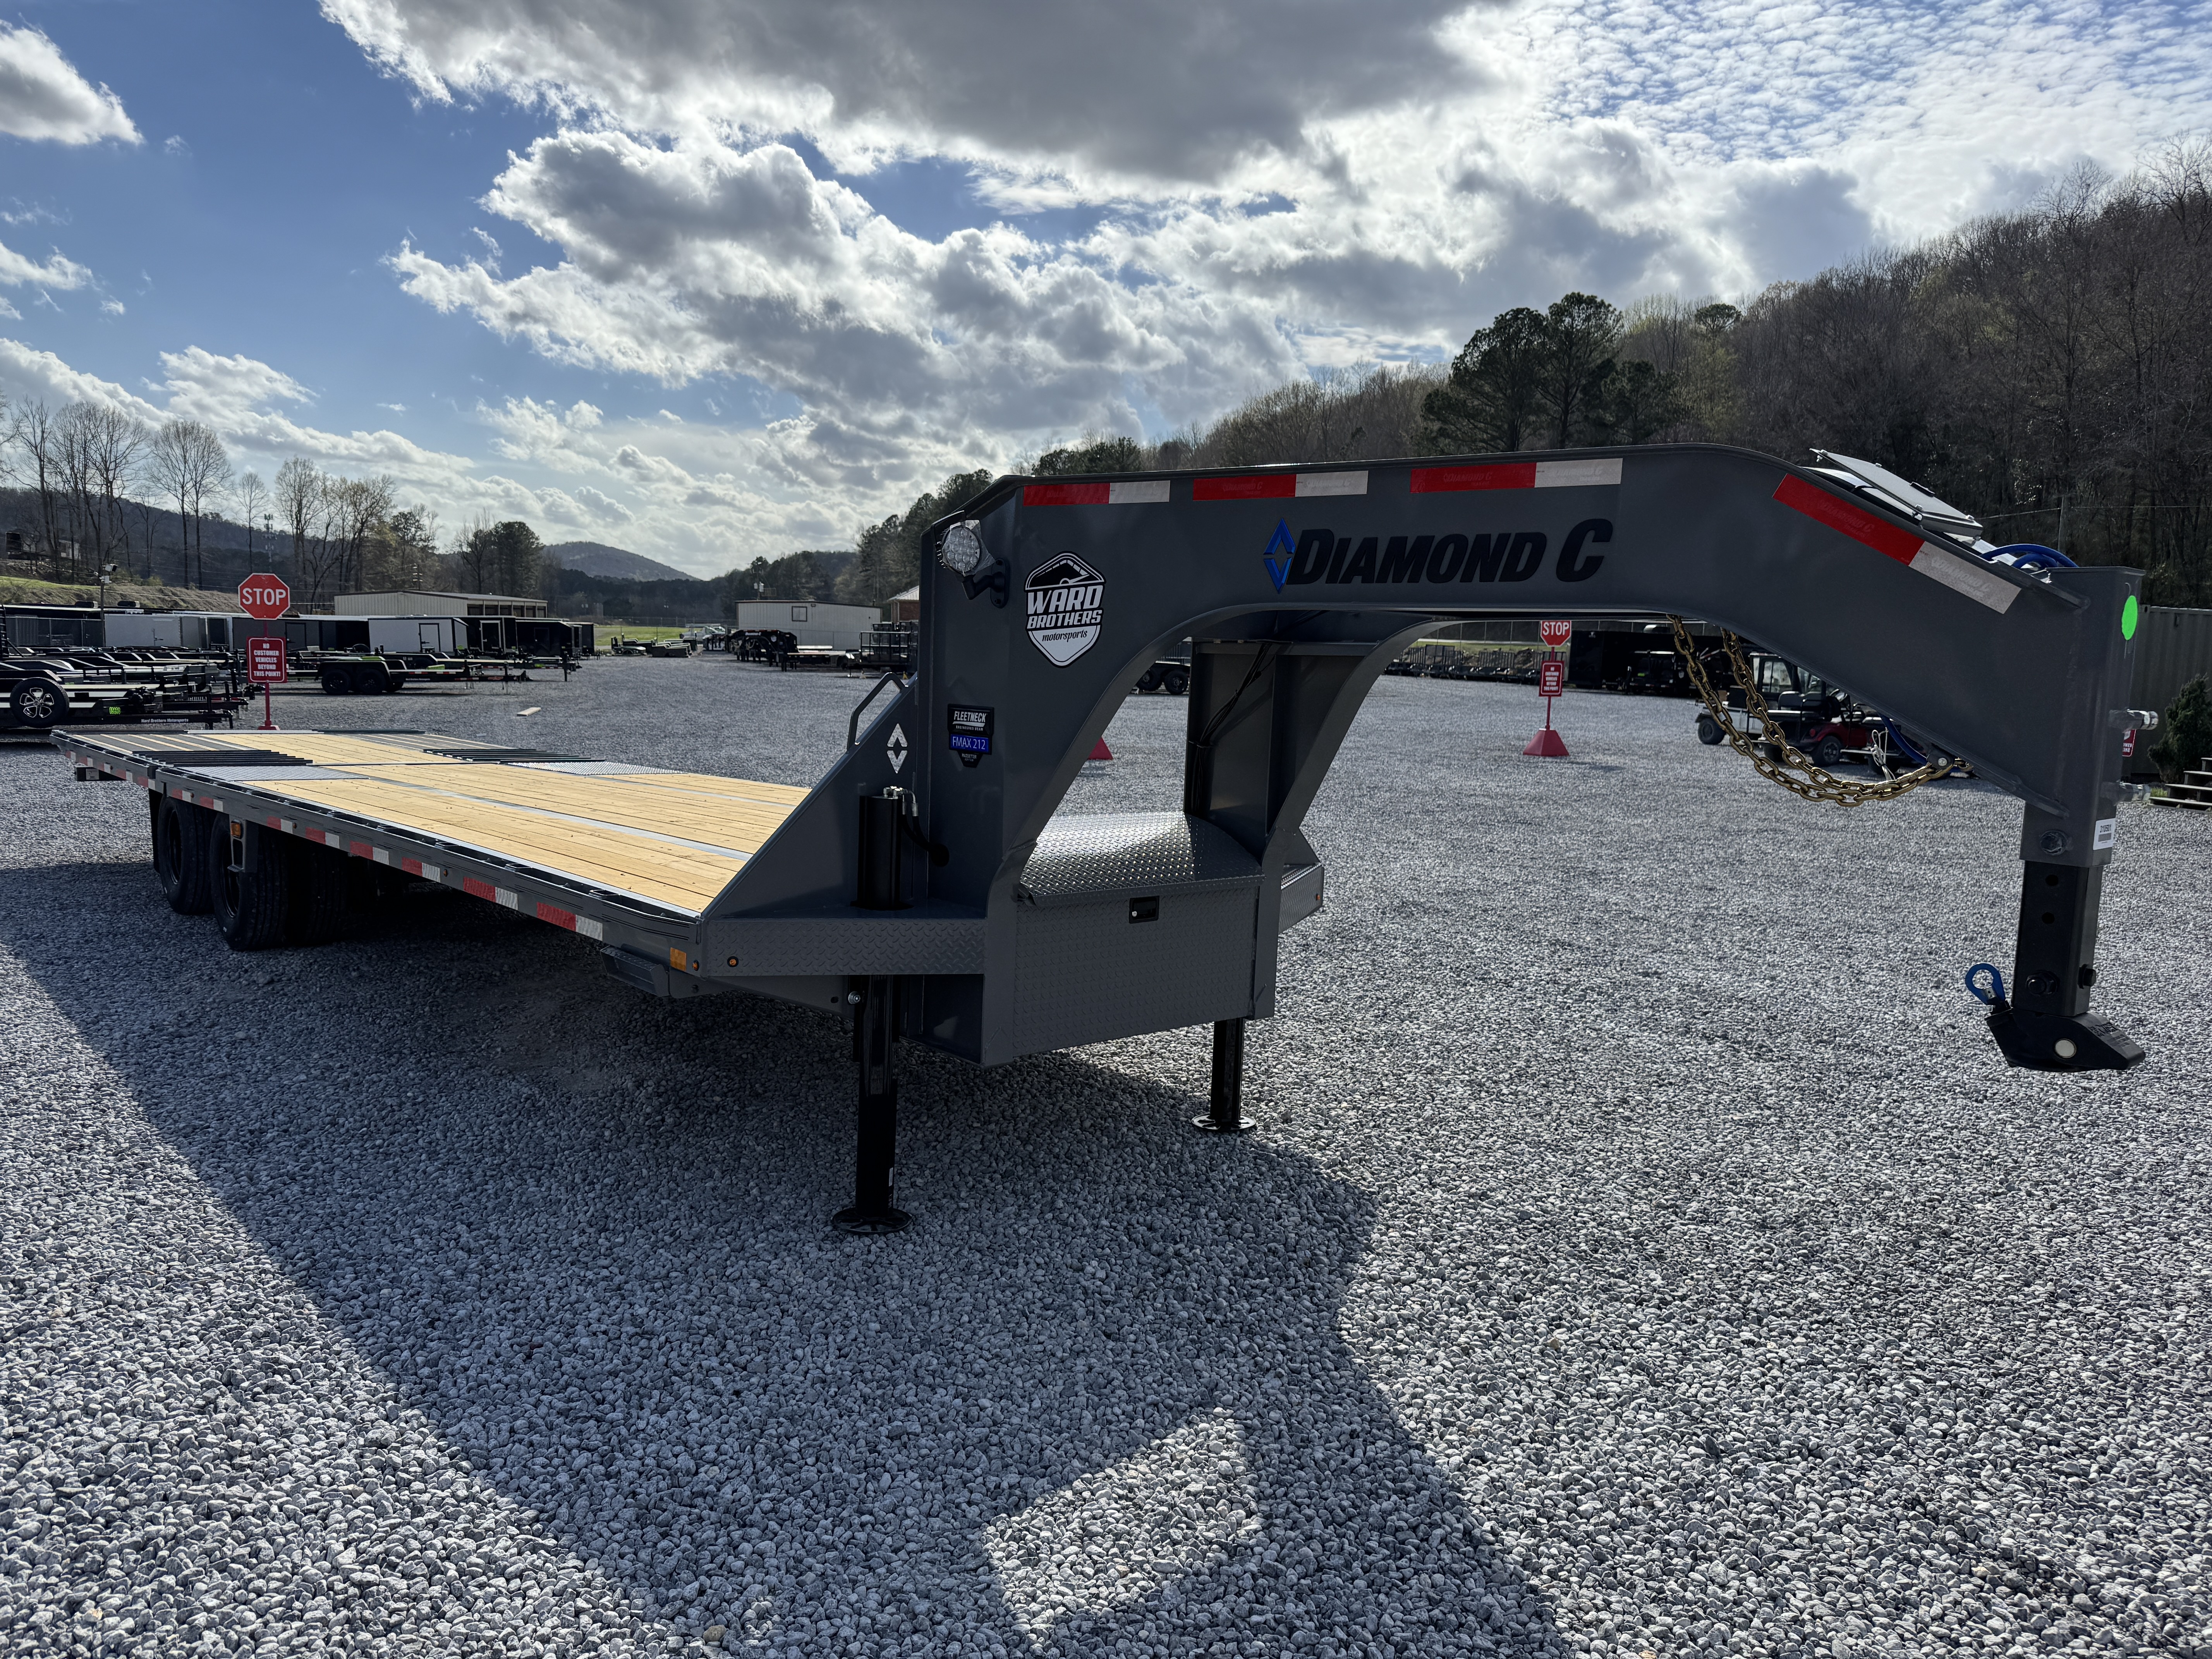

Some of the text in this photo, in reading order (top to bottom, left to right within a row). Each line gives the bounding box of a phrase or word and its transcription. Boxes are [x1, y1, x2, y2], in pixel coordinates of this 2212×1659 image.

[1286, 519, 1613, 585] DIAMOND C
[242, 588, 286, 605] STOP
[1027, 585, 1103, 614] WARD
[1027, 610, 1103, 629] BROTHERS
[1042, 629, 1088, 642] motorsports
[1542, 622, 1569, 635] STOP
[954, 711, 986, 723] FLEETNECK
[953, 736, 985, 750] FMAX 212
